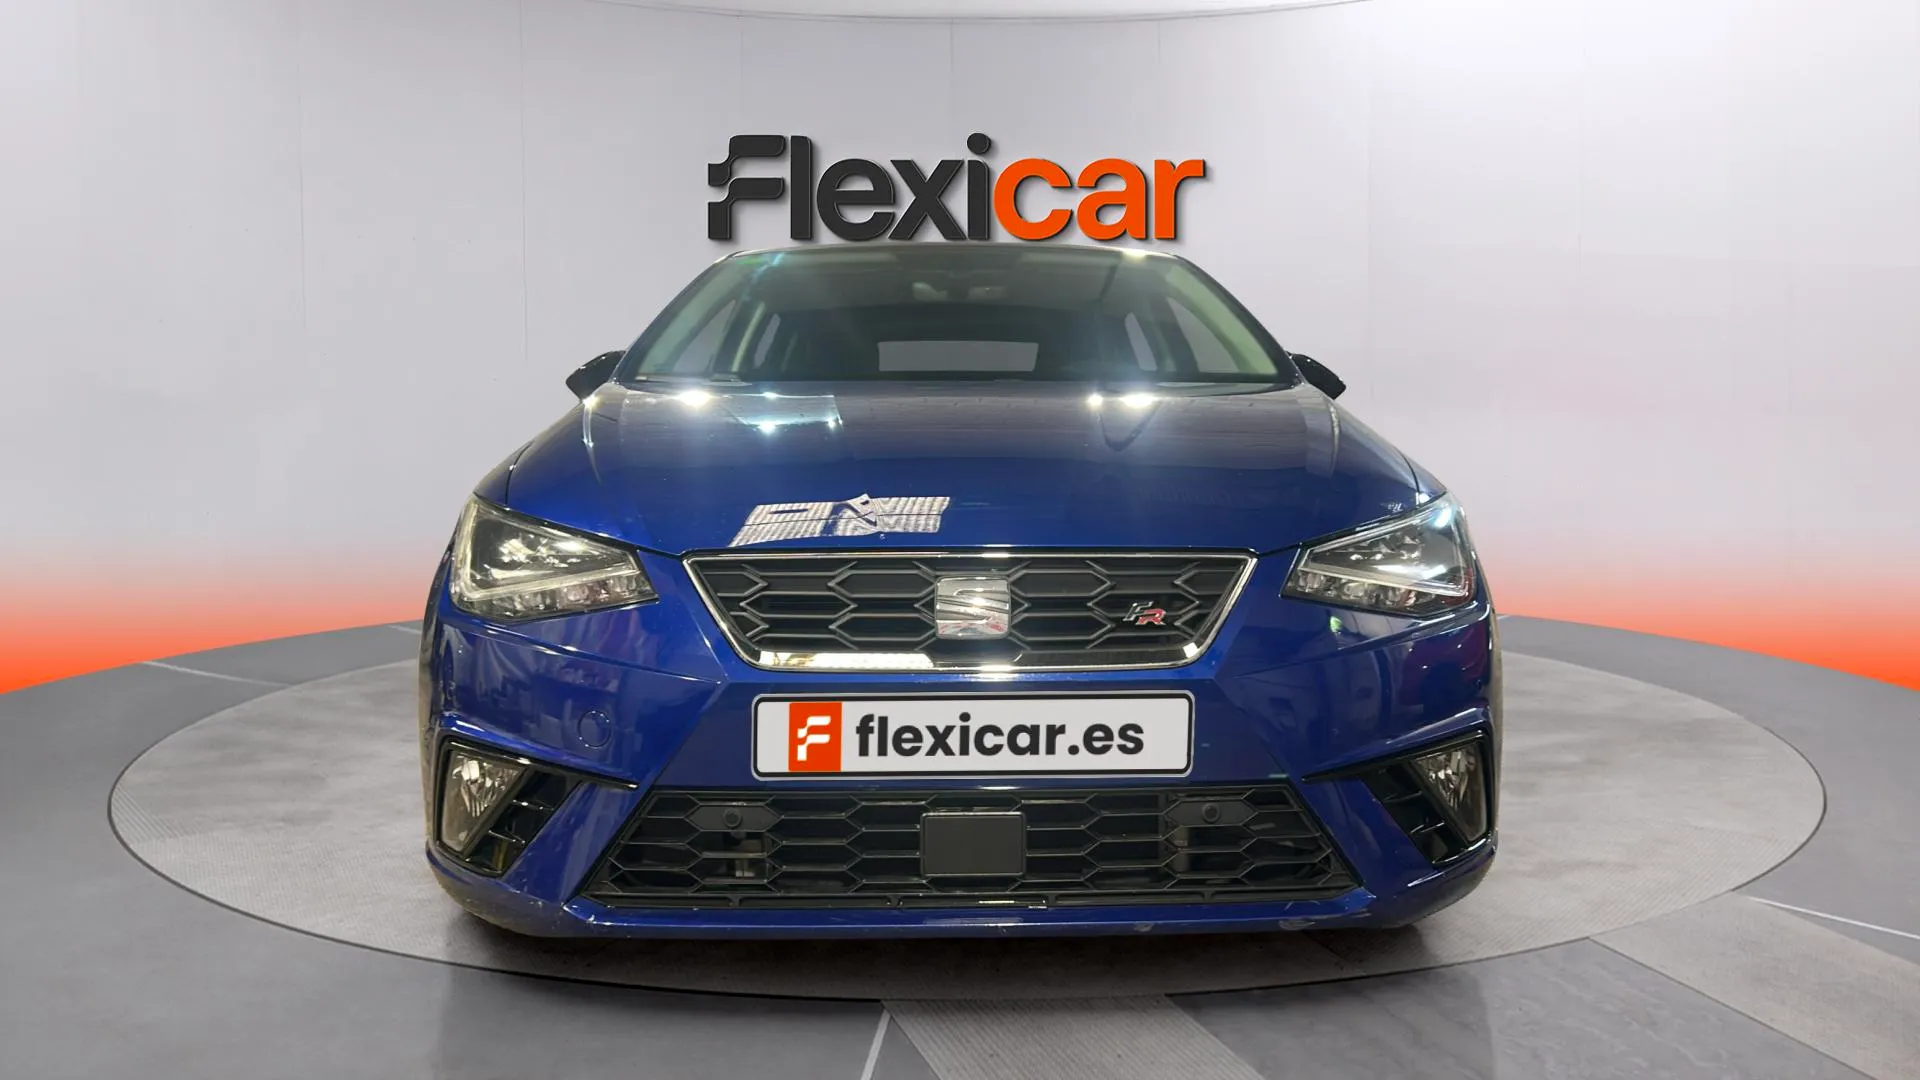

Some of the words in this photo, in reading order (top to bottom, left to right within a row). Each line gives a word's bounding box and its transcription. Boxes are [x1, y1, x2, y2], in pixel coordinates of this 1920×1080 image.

[708, 133, 1204, 241] Flexicar
[1123, 601, 1167, 626] FR
[856, 712, 1144, 757] flexicar.es
